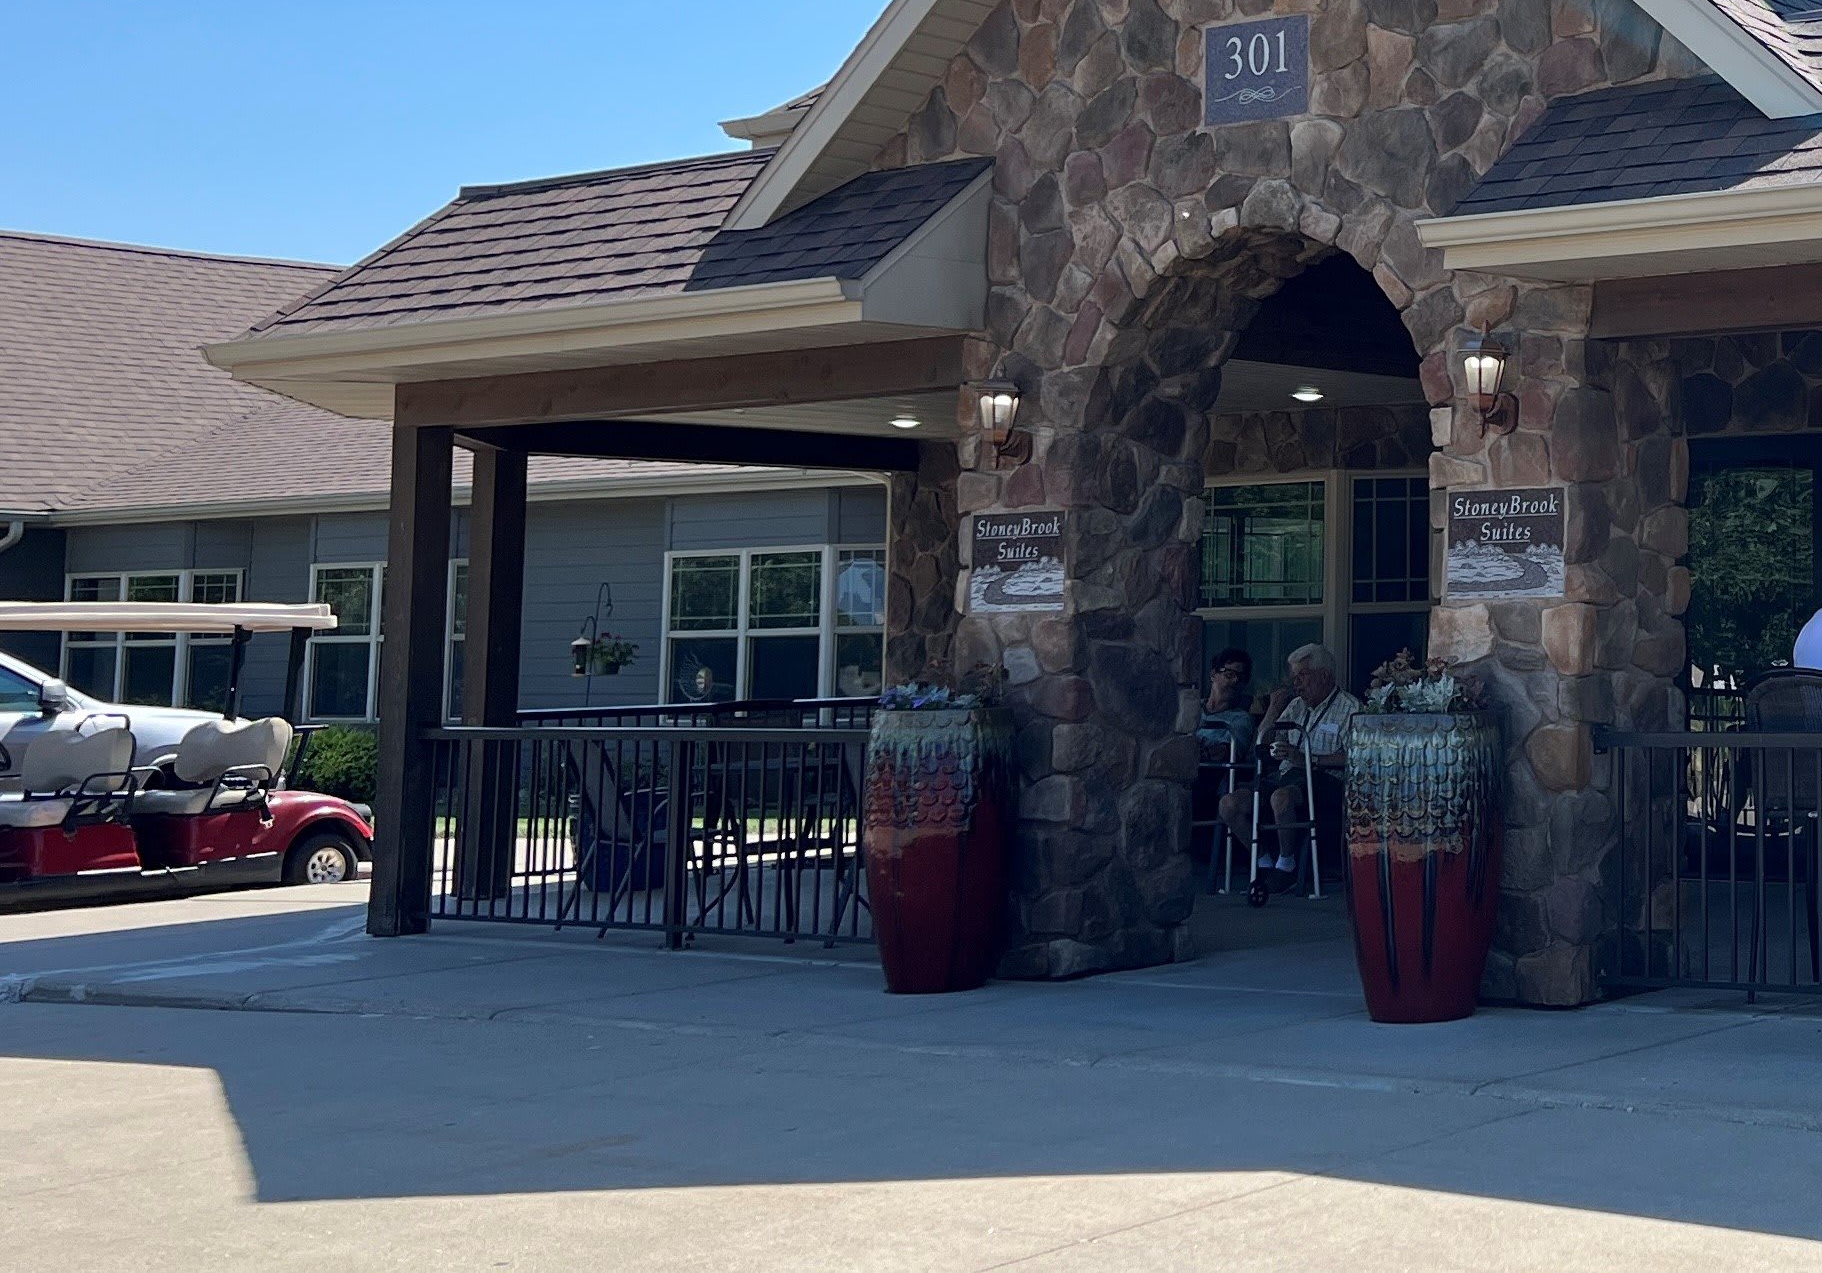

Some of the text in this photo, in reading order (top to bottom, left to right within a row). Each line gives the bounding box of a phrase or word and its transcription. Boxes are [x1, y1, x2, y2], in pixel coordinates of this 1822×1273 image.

[1224, 29, 1288, 80] 301
[1454, 494, 1559, 519] StoneyBrook
[976, 517, 1060, 539] StoneyBrook
[1479, 522, 1532, 541] Suites
[997, 541, 1040, 560] Suites
